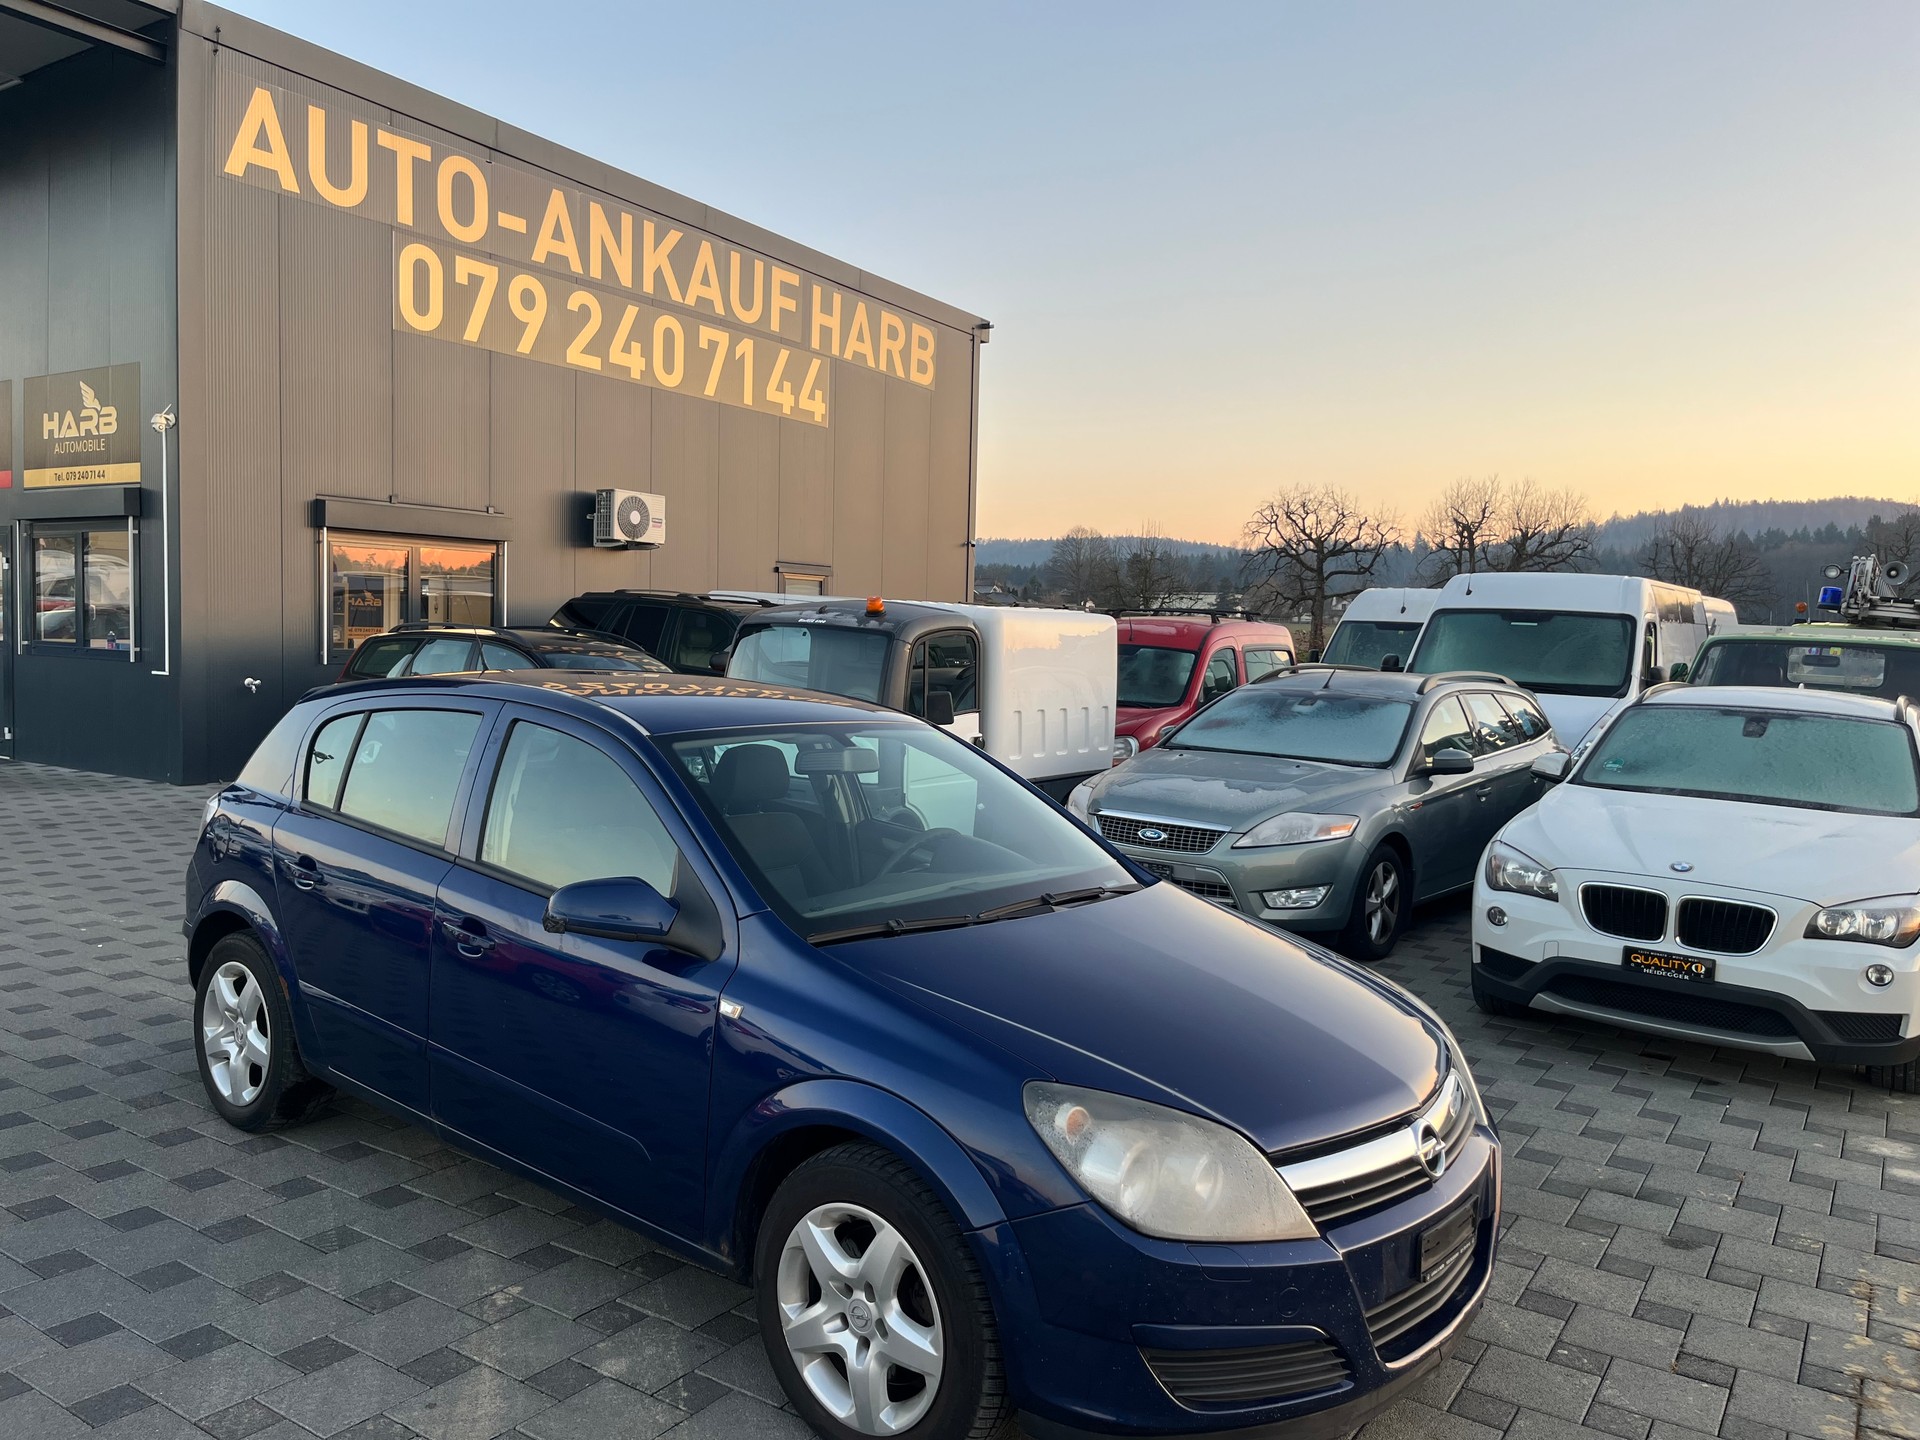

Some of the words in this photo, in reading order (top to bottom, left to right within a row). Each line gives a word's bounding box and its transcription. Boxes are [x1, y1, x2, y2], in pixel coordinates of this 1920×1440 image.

[224, 87, 800, 332] AUTO-ANKAUF
[811, 285, 935, 386] HARB
[398, 243, 548, 355] 079
[565, 290, 685, 388] 240
[698, 325, 754, 407] 71
[765, 348, 827, 423] 44
[43, 406, 118, 440] HARB
[53, 438, 106, 455] AUTOMOBILE
[65, 471, 77, 481] 079
[77, 470, 89, 480] 240
[1630, 953, 1691, 971] QUALITY
[1643, 968, 1690, 981] HEIDEGGER
